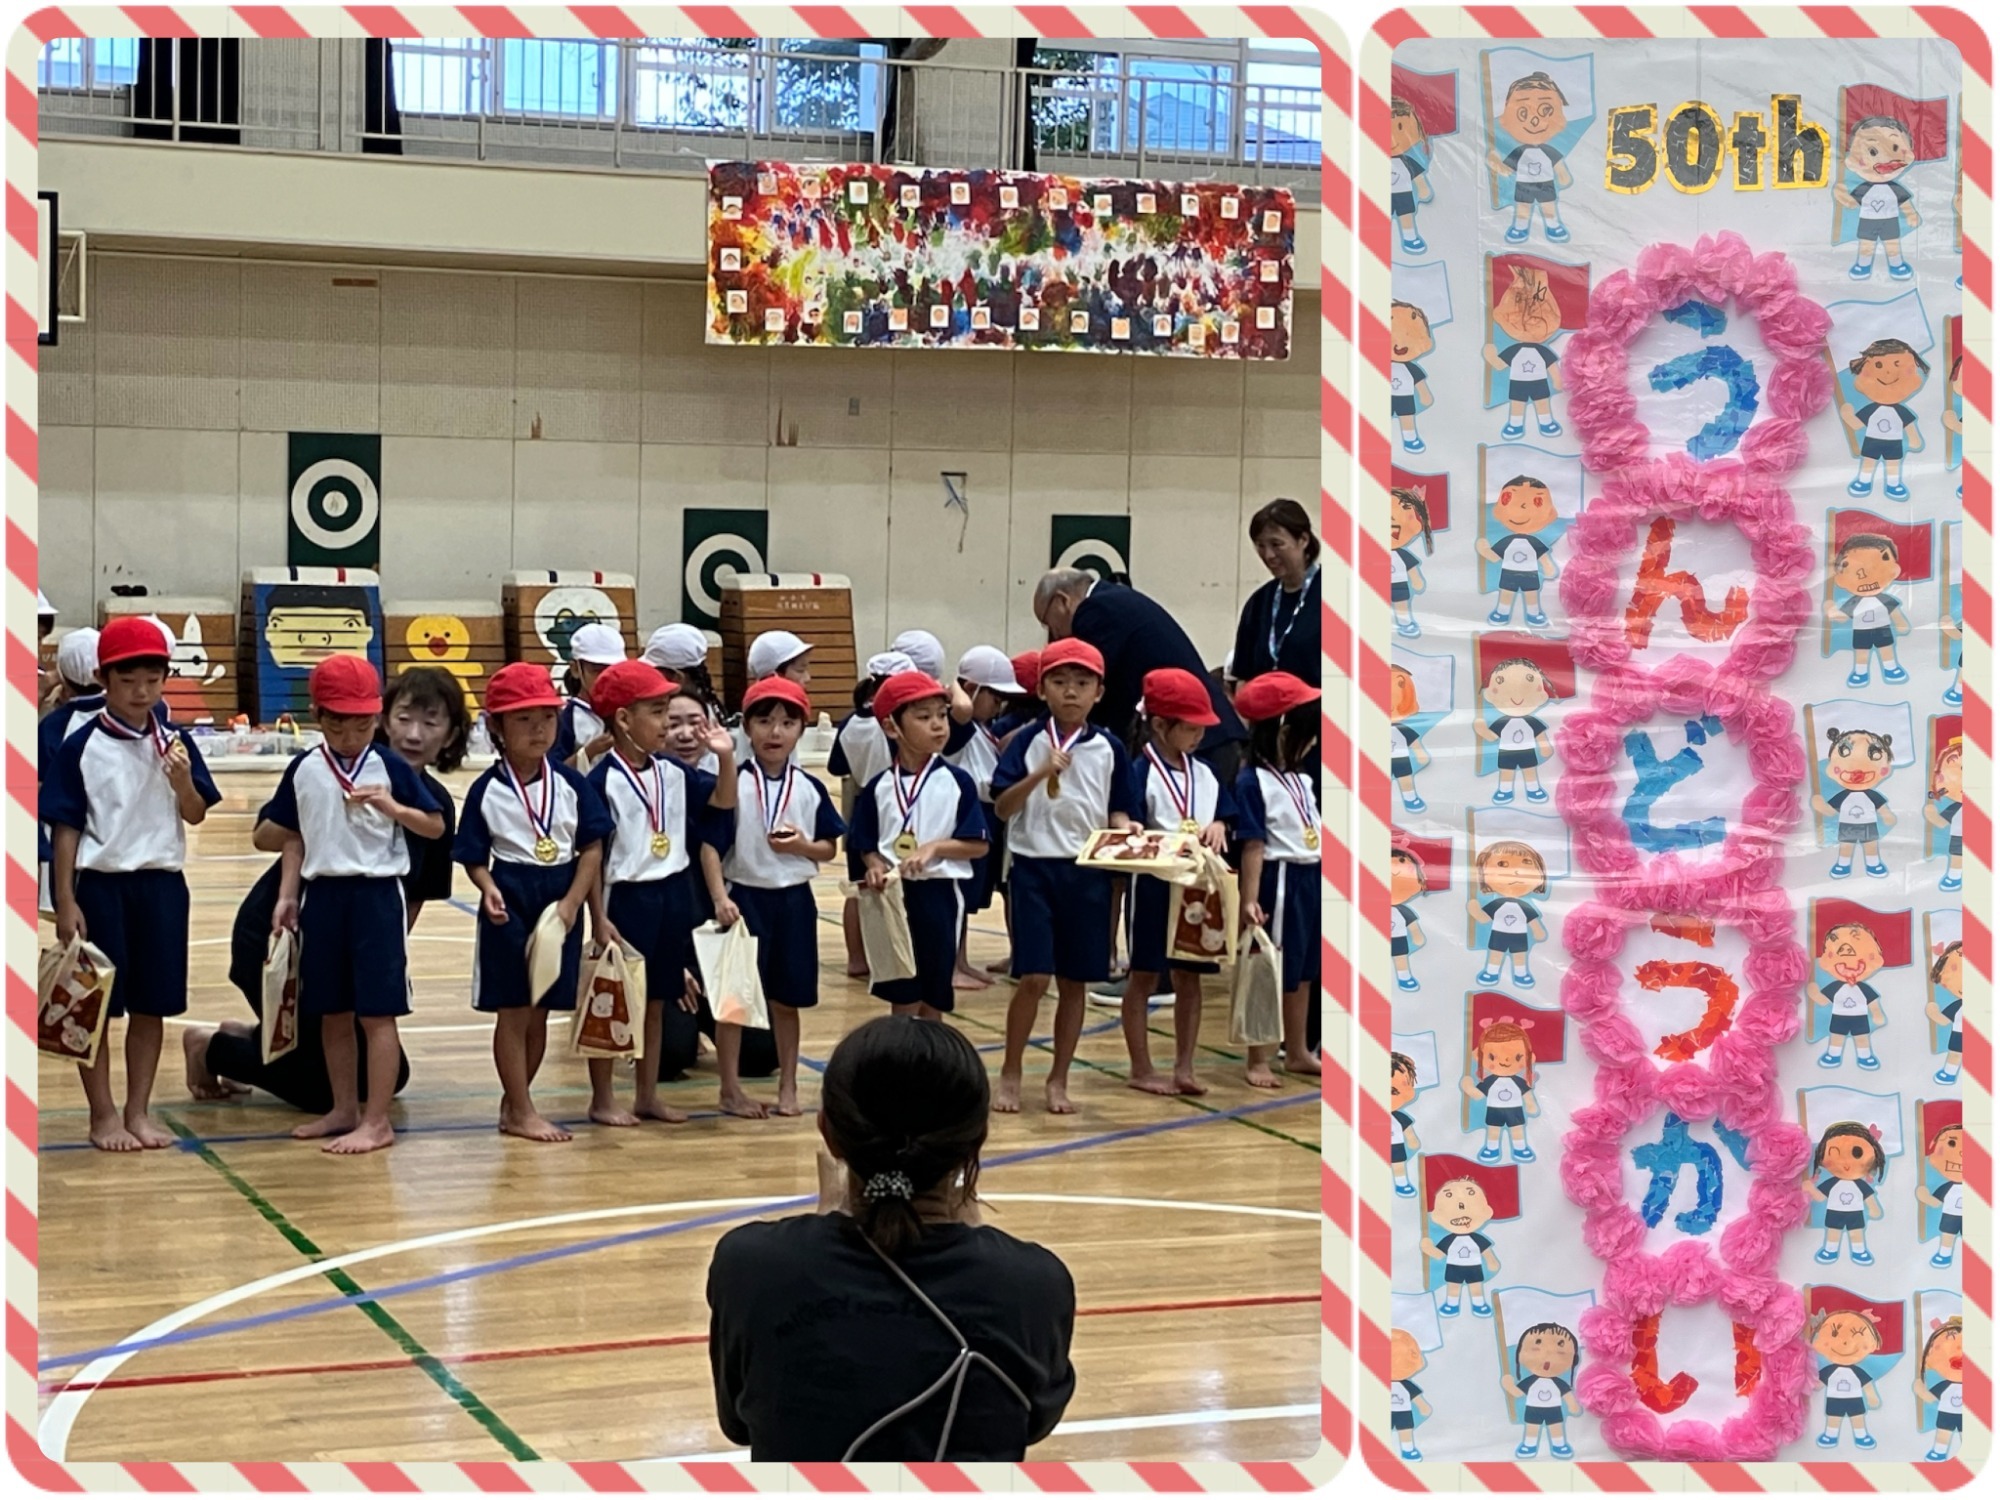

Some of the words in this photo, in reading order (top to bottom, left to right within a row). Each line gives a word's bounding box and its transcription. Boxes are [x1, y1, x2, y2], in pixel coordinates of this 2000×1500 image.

[1604, 93, 1831, 195] 50th
[1622, 299, 1761, 1414] うんどうかい
